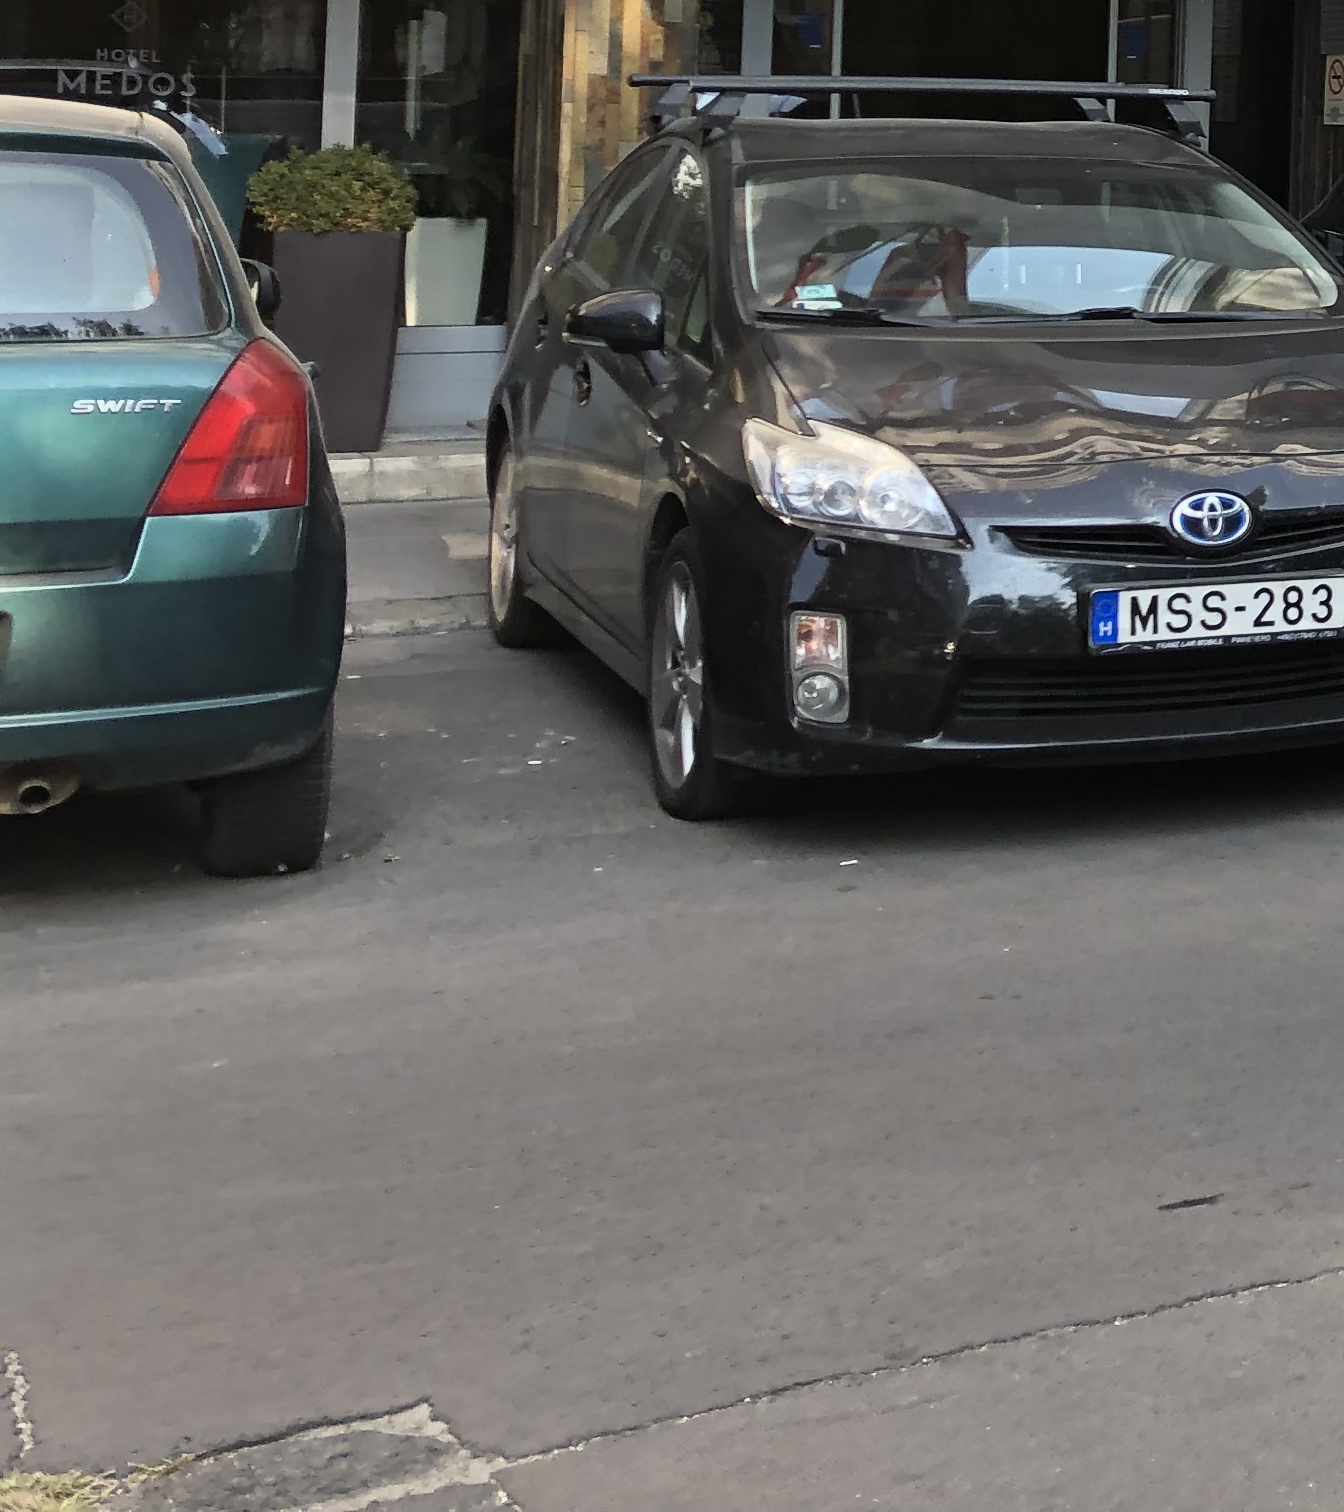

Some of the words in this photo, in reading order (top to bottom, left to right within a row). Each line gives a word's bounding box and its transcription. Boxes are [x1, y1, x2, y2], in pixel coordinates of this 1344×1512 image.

[96, 48, 161, 64] HOTEL
[56, 69, 197, 97] MEDOS
[70, 399, 182, 414] SWIFT
[1098, 620, 1113, 637] H
[1130, 584, 1334, 637] MSS-283
